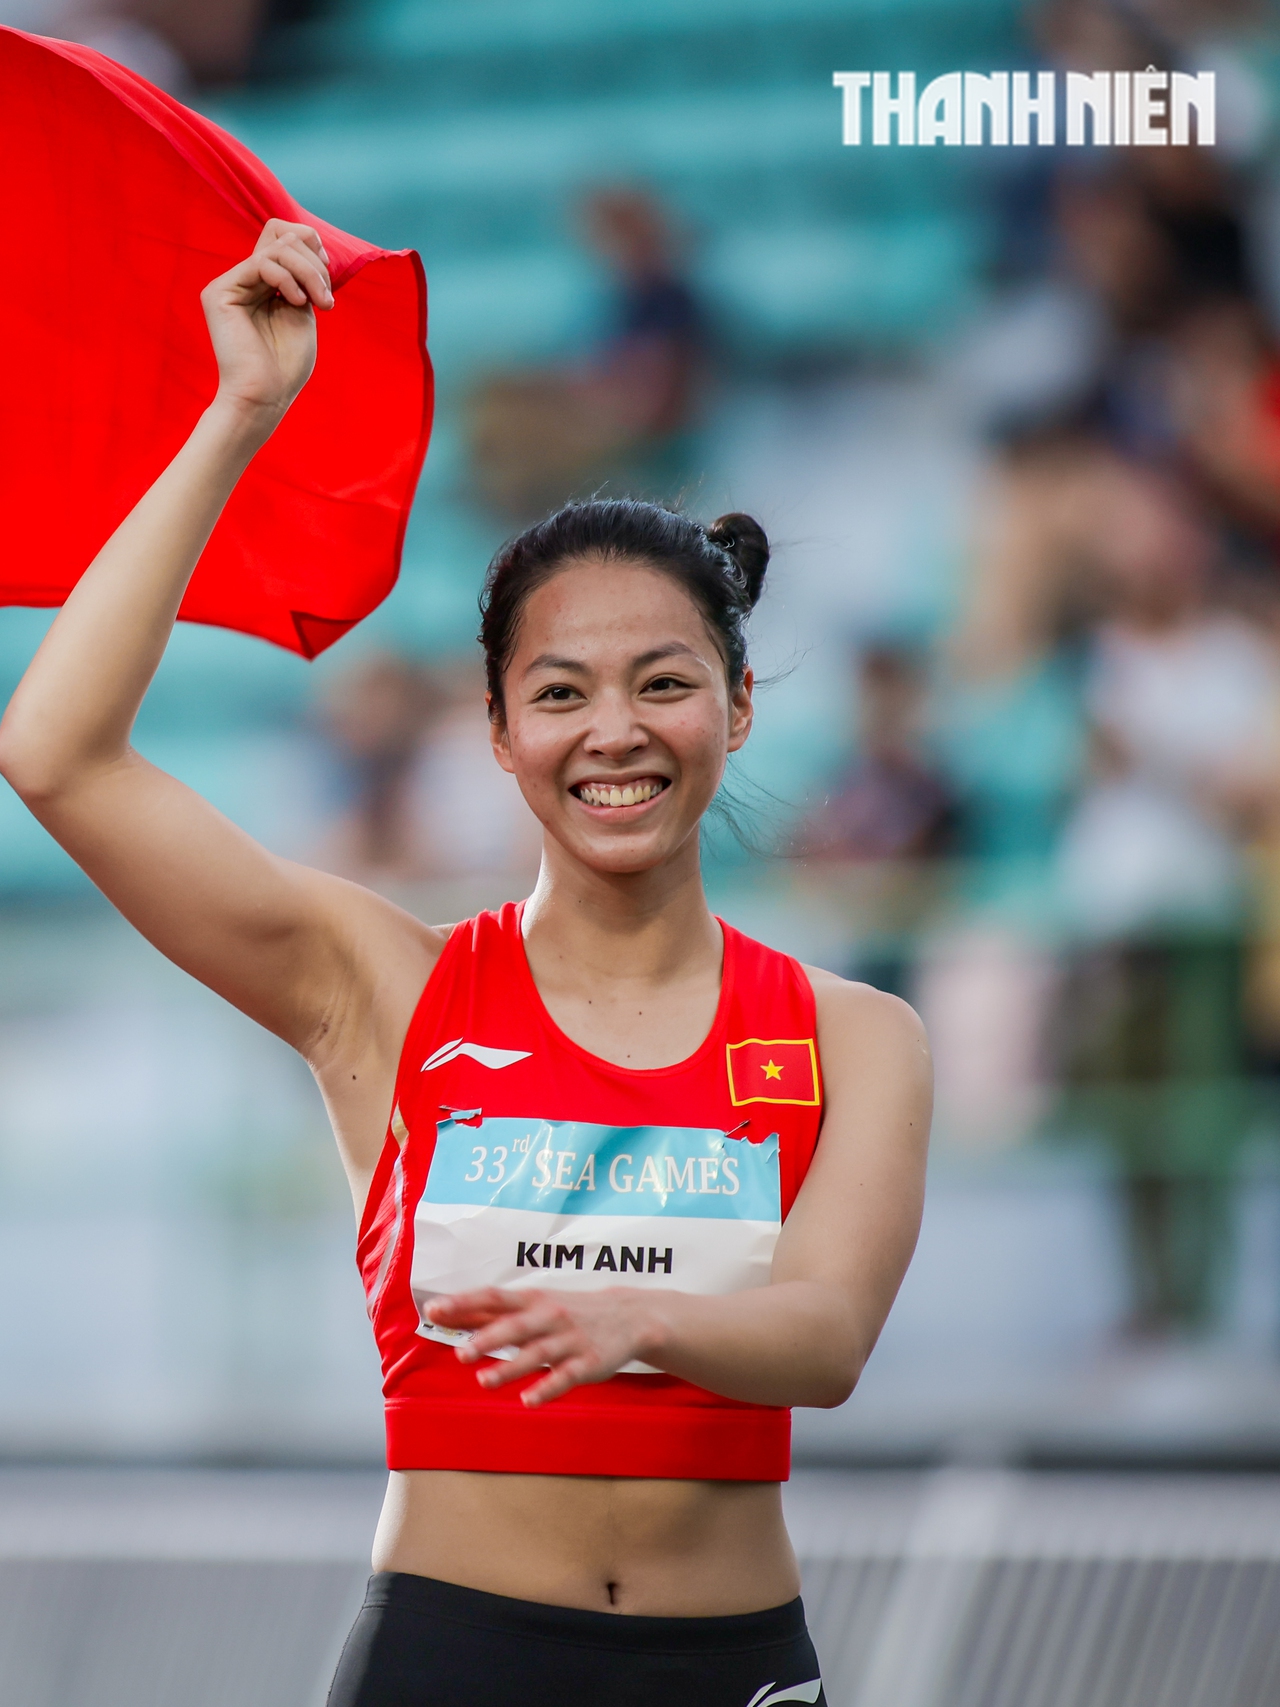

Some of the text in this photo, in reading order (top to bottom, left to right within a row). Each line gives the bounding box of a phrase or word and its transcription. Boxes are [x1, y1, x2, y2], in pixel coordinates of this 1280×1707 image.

[531, 1148, 596, 1191] SEA
[608, 1153, 740, 1196] GAMES
[516, 1241, 673, 1274] KIM ANH
